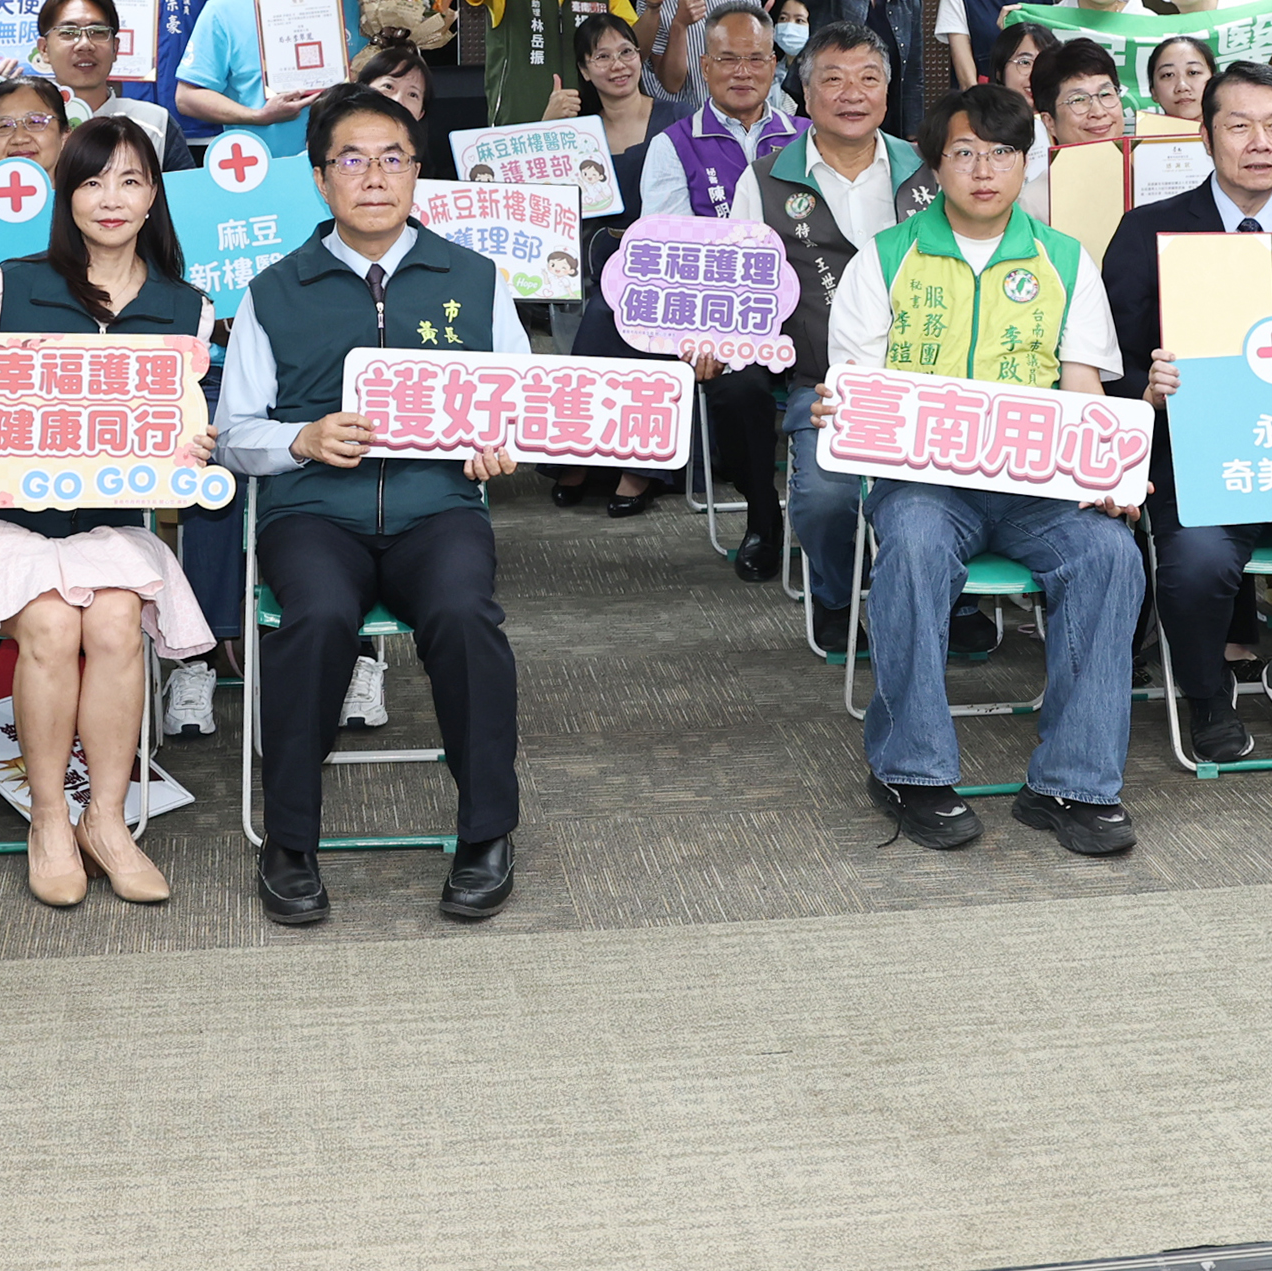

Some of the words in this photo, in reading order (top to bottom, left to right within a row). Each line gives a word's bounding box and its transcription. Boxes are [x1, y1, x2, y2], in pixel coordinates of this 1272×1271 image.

[530, 17, 545, 65] 林岳振
[475, 130, 579, 163] 麻豆新樓醫院
[499, 154, 573, 184] 護理部
[217, 213, 283, 252] 麻豆
[427, 187, 578, 241] 麻豆新樓醫院
[445, 225, 544, 264] 護理部
[622, 239, 781, 290] 幸福護理
[188, 251, 295, 292] 新樓
[516, 277, 539, 290] Hope
[909, 278, 923, 310] 秘書
[416, 320, 439, 345] 黃
[443, 299, 464, 344] 市長
[618, 284, 779, 335] 健康同行
[919, 285, 948, 375] 服務團
[889, 310, 913, 371] 李鎧
[996, 324, 1024, 383] 李啟
[1025, 307, 1045, 386] 台南市議員
[356, 359, 683, 461] 護好護滿
[830, 373, 1126, 490] 臺南用心
[21, 469, 83, 501] GO
[95, 464, 157, 496] GO
[170, 466, 231, 503] GO
